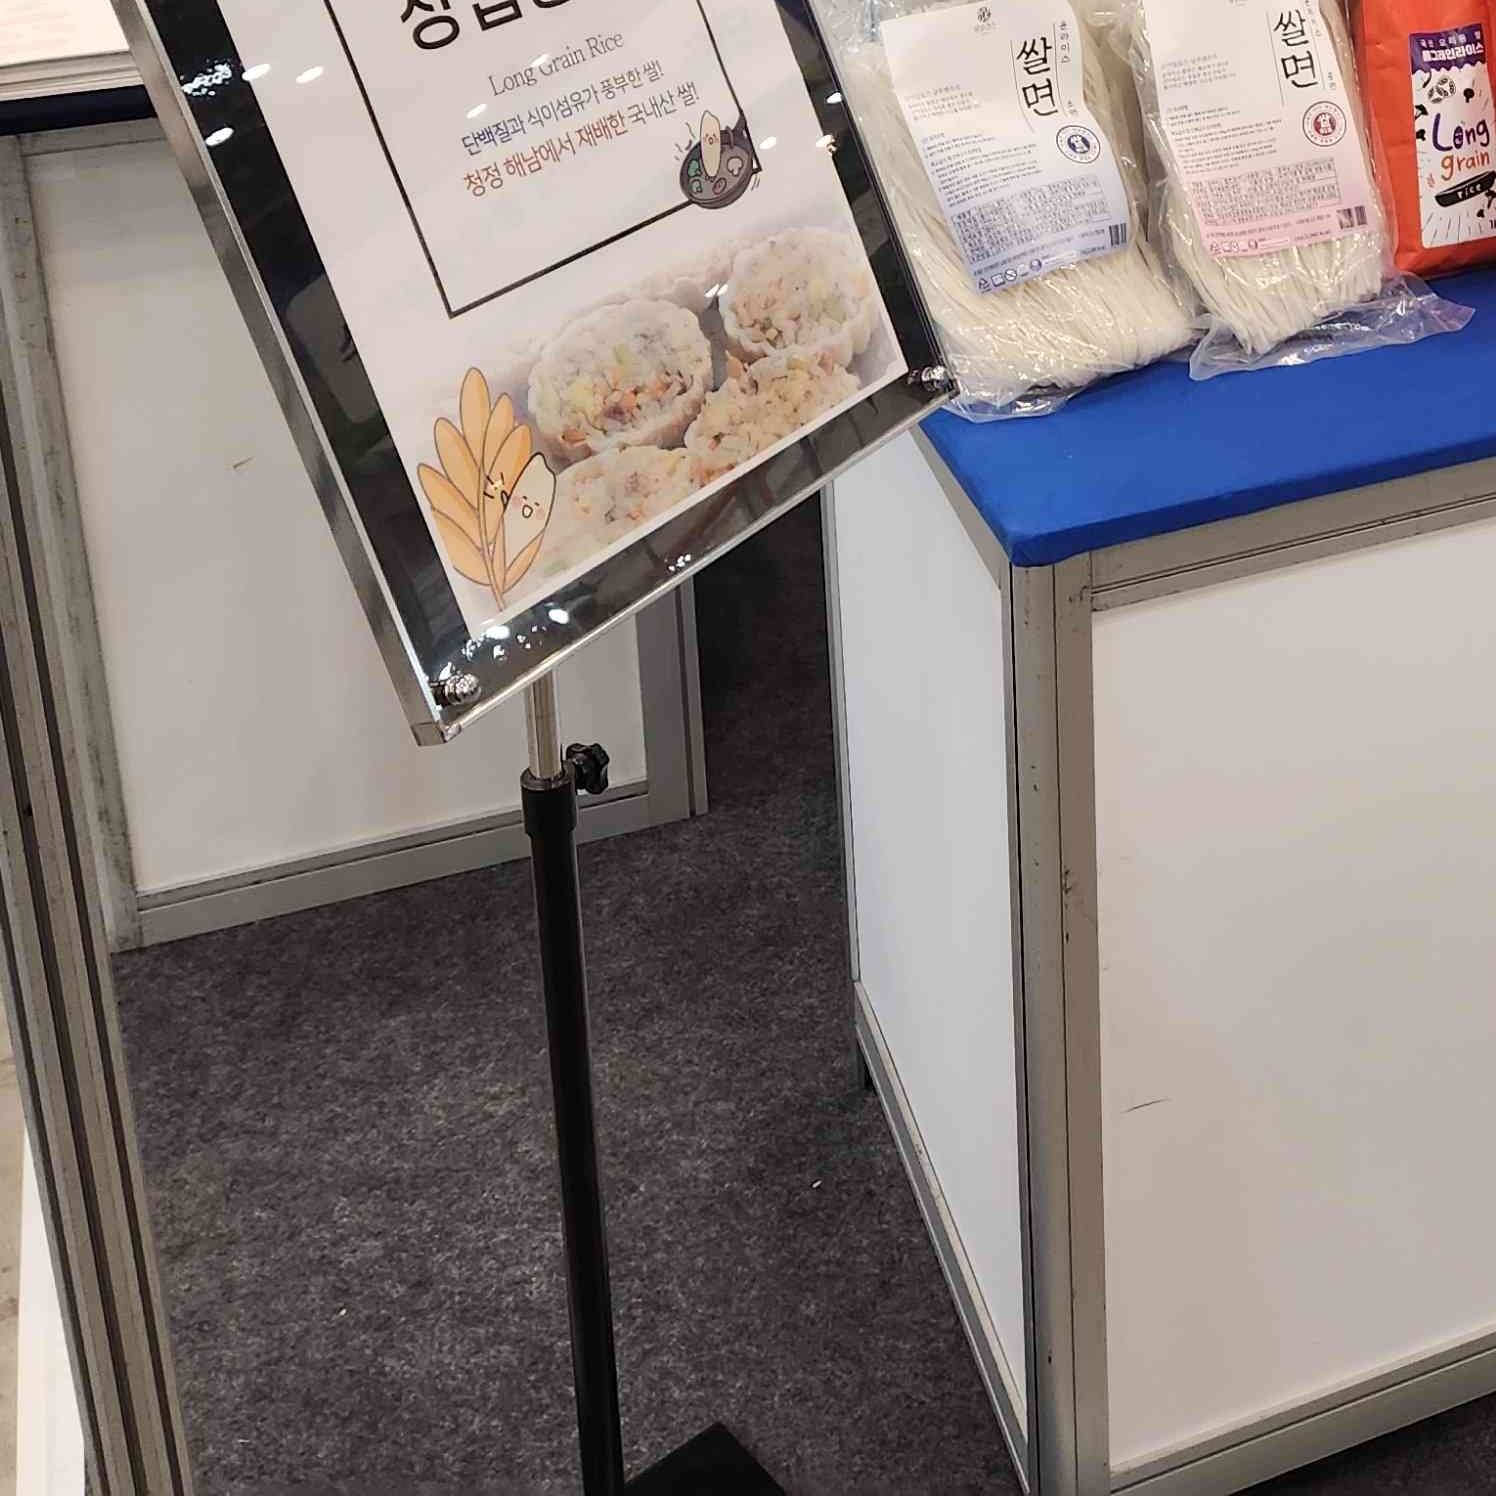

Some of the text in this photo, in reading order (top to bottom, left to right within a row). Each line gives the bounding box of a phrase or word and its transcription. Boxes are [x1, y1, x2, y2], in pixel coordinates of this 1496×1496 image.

[488, 66, 538, 97] Long
[586, 31, 625, 59] Rice
[1016, 36, 1059, 117] 쌀면
[1273, 8, 1319, 88] 쌀면
[461, 59, 665, 156] 단백질과 식이섬유가 풍부한 쌀!
[463, 80, 701, 197] 청정 해남에서 재배한 국내산 쌀!
[1431, 112, 1491, 152] Long
[1440, 151, 1491, 182] grain
[1456, 180, 1484, 200] rice
